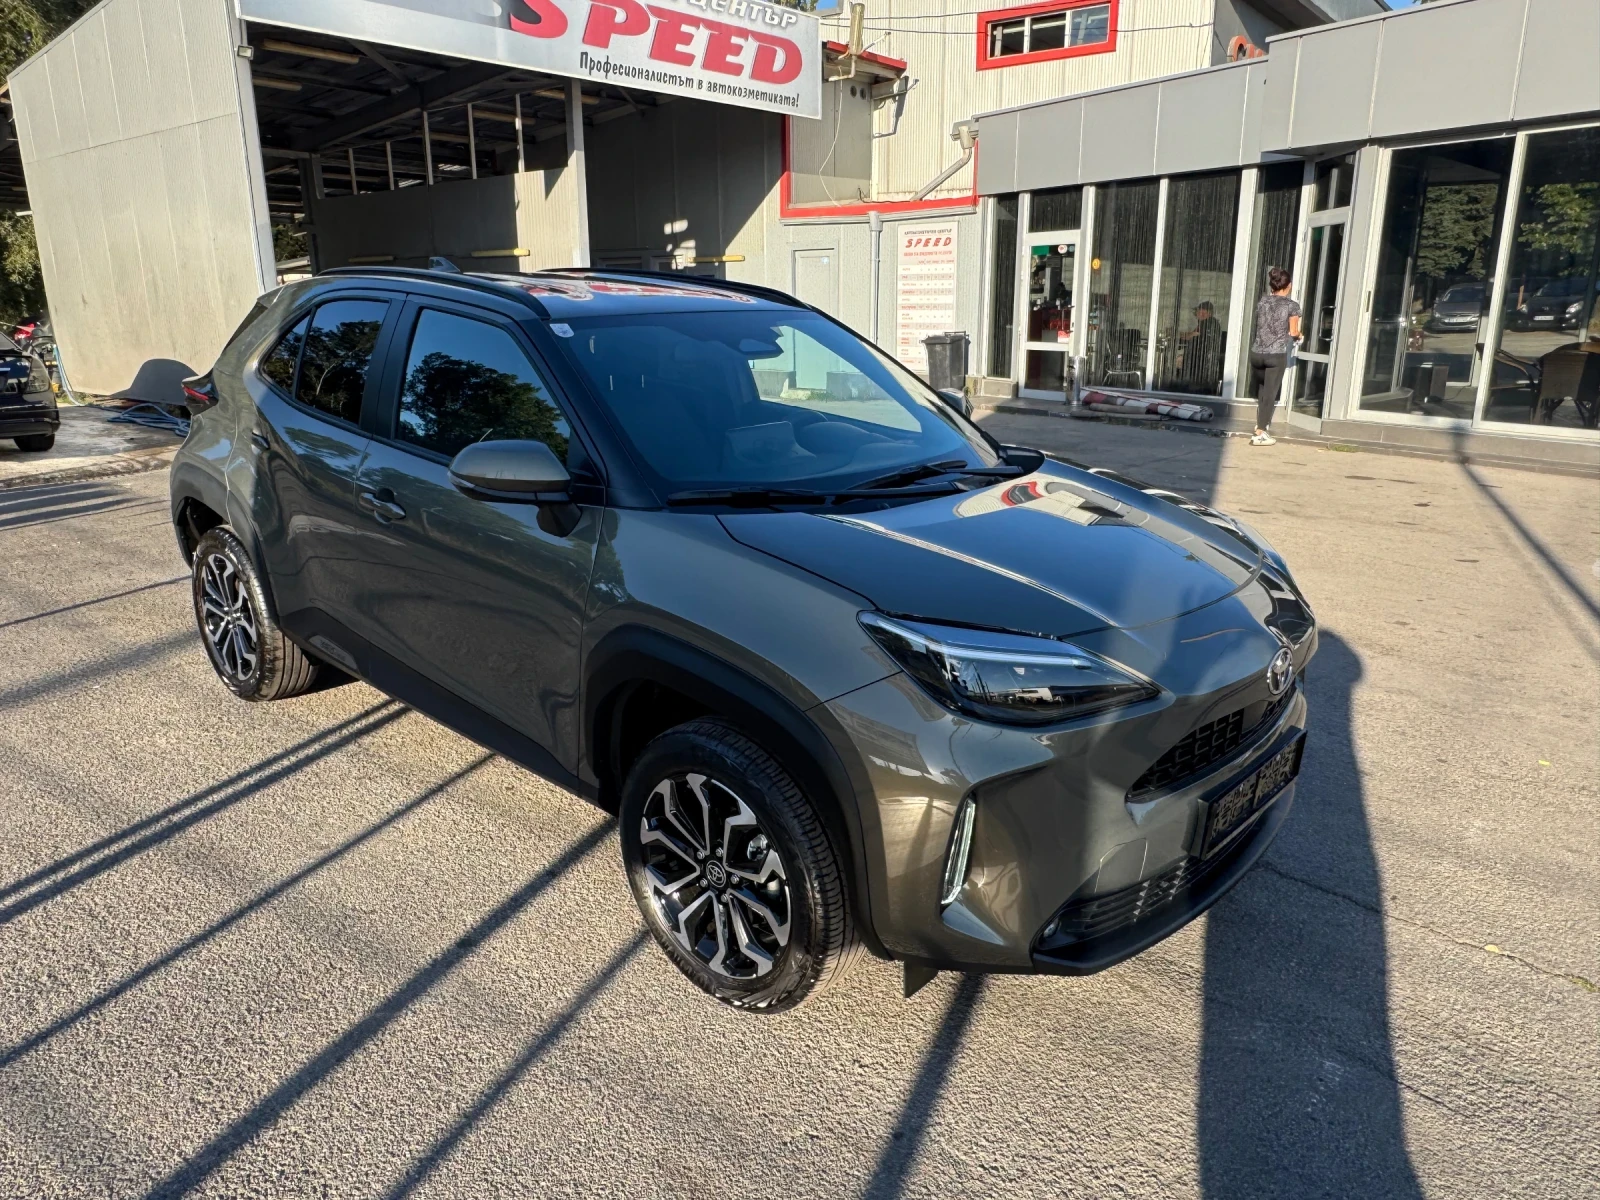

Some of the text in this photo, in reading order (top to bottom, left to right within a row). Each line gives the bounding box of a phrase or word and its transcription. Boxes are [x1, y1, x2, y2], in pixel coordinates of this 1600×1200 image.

[509, 0, 802, 85] SPEED
[580, 51, 800, 108] Професионалистът в автокозметиката!
[905, 236, 952, 248] SPEED
